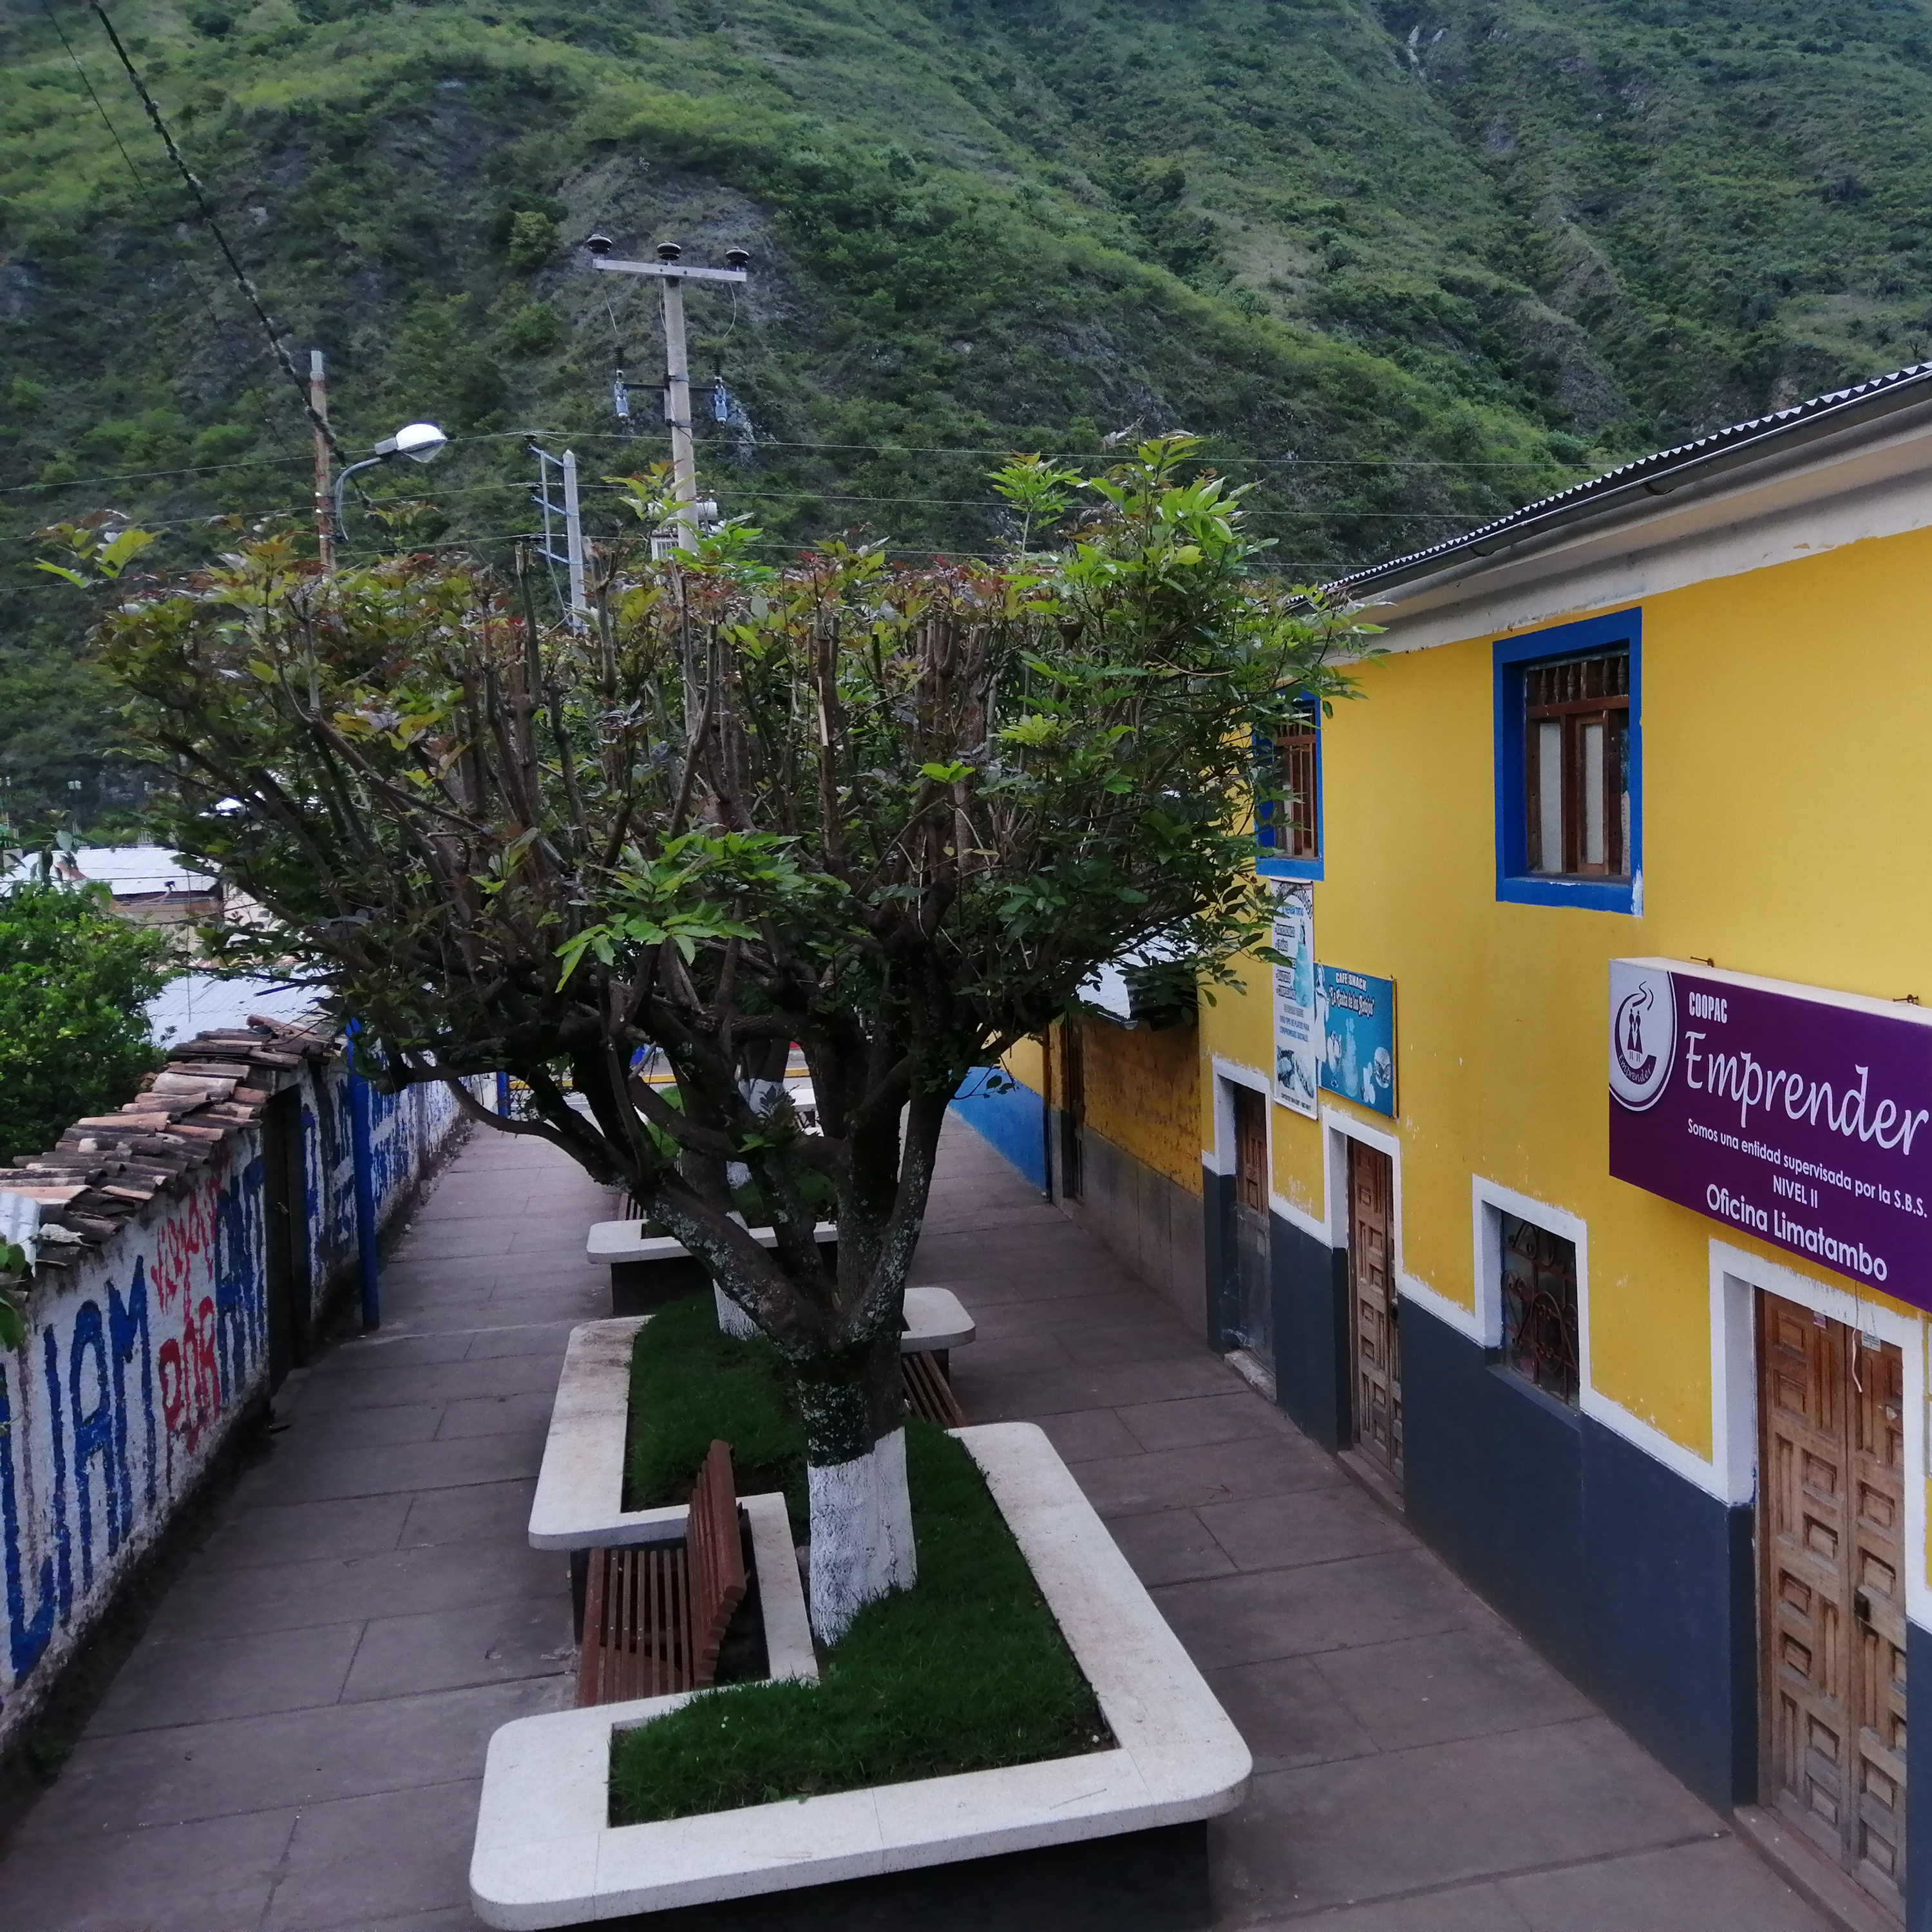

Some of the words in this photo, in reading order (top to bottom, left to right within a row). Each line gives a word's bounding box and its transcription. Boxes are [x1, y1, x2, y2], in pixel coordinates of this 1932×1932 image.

[1336, 972, 1348, 985] CAFE
[1689, 991, 1727, 1024] COOPAC
[1618, 1052, 1651, 1083] Emprender
[1685, 1031, 1929, 1157] Emprender
[1688, 1118, 1718, 1142] Somos
[1720, 1132, 1739, 1150] una
[1741, 1140, 1781, 1165] entidad
[1783, 1155, 1852, 1191] supervisada
[1855, 1180, 1876, 1198] por
[1879, 1184, 1891, 1204] la
[1893, 1193, 1928, 1218] S.B.S.
[1773, 1175, 1807, 1205] NIVEL
[1810, 1188, 1819, 1209] II
[1707, 1184, 1768, 1232] Oficina
[1774, 1209, 1888, 1282] Limatambo
